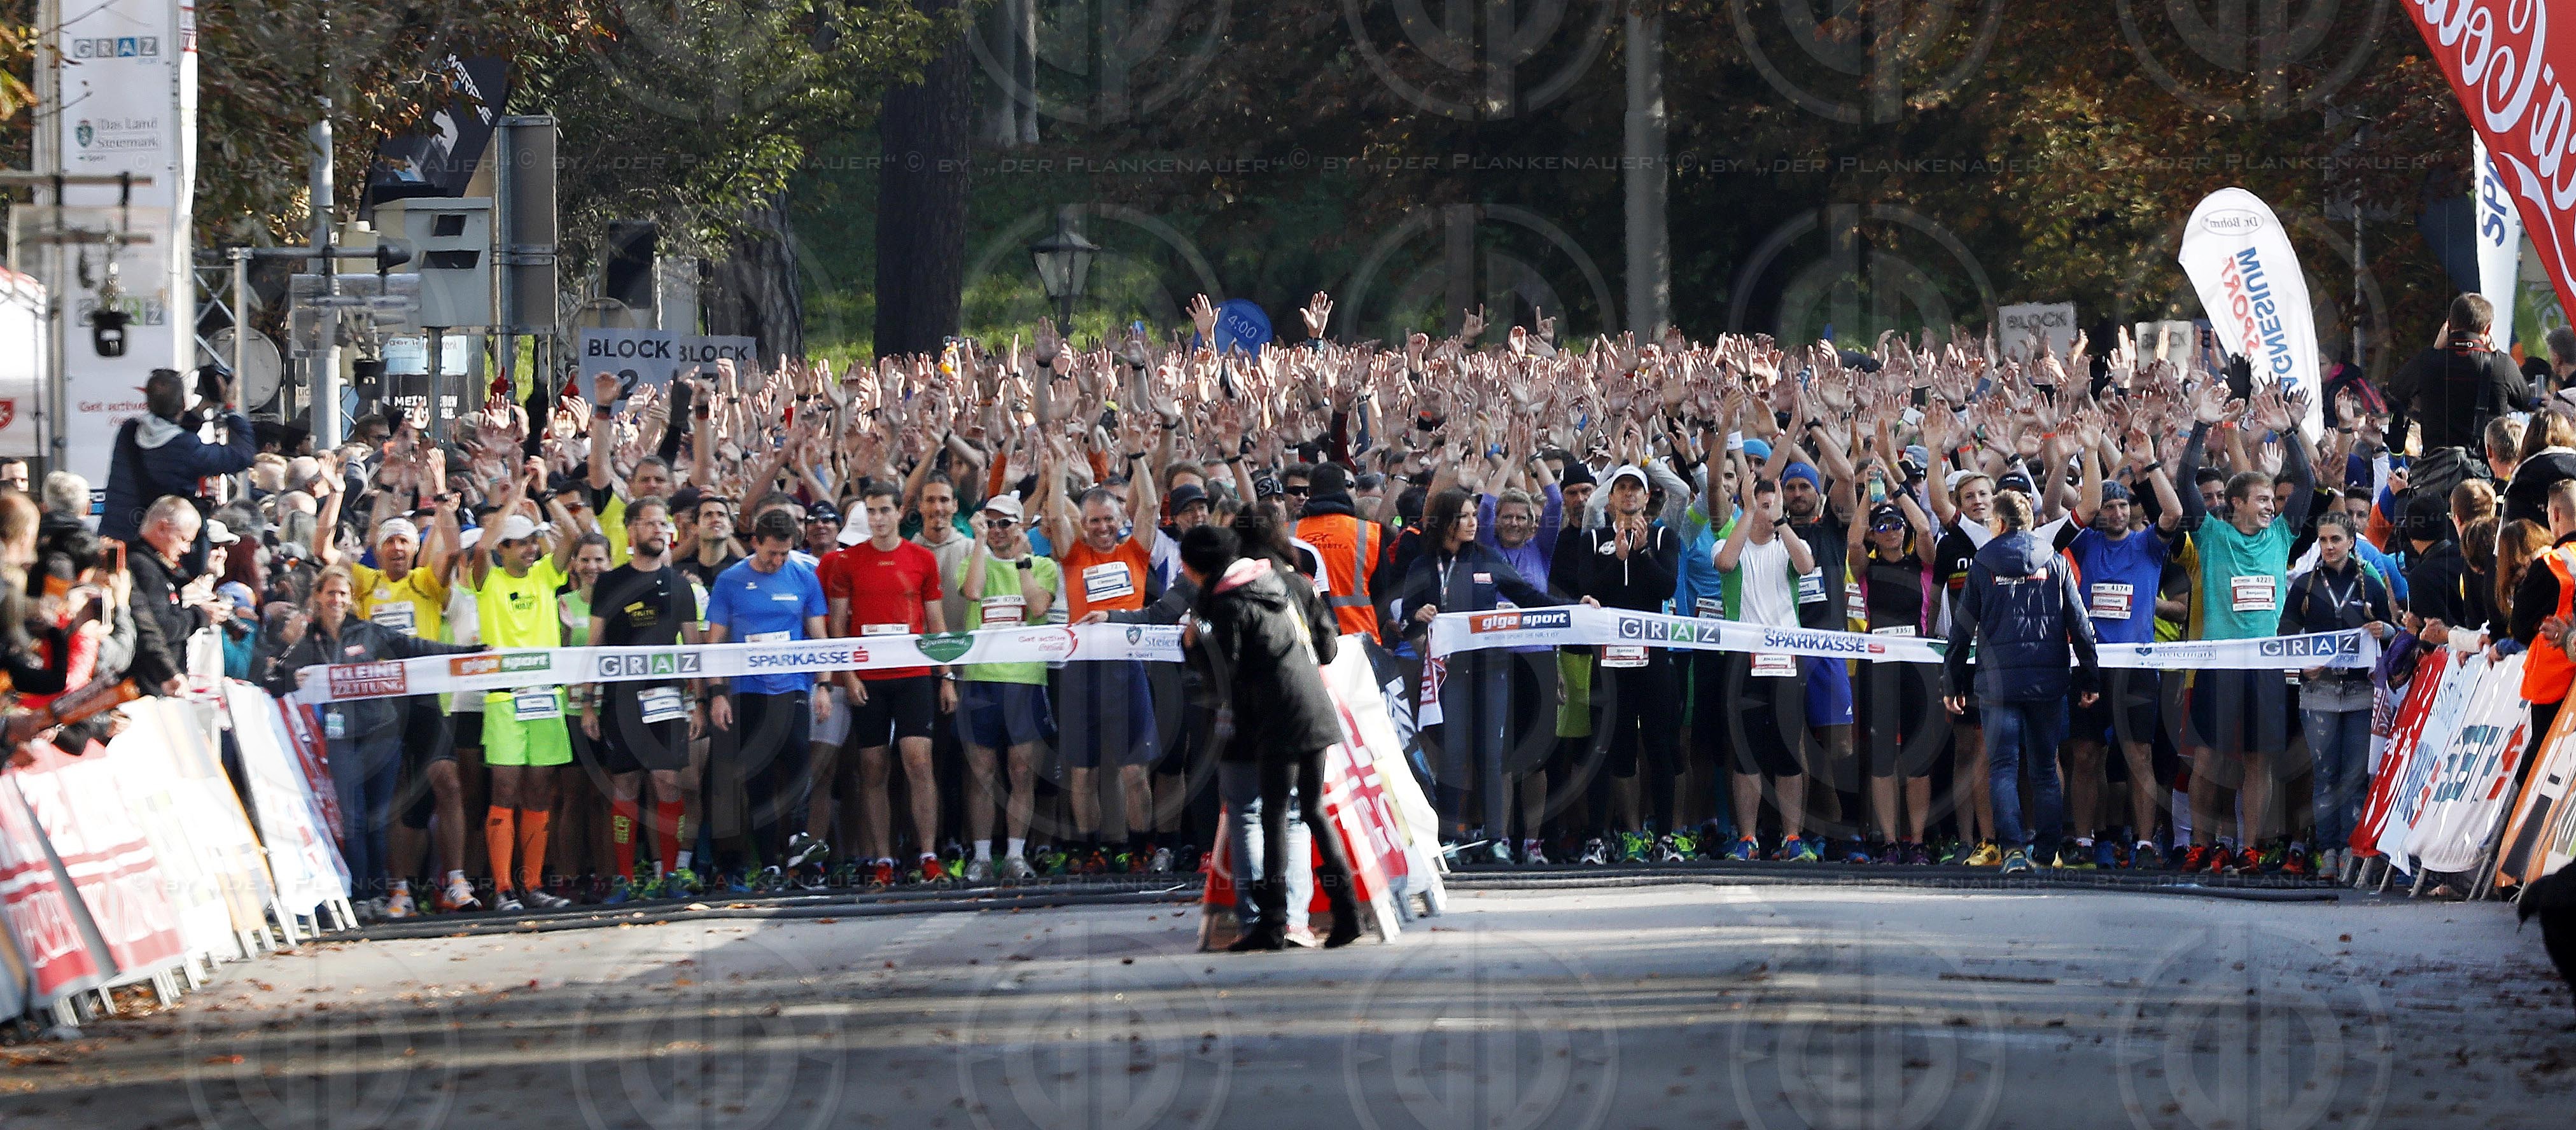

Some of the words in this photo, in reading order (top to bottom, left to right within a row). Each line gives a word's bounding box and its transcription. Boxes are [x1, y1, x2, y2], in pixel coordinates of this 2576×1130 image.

[74, 37, 157, 58] GRAZ
[1228, 316, 1257, 338] 4:00
[588, 338, 671, 358] BLOCK
[617, 368, 639, 401] 2
[1482, 615, 1518, 631] giga
[1522, 613, 1567, 627] sport
[1622, 618, 1717, 642] GRAZ
[1765, 635, 1865, 653] SPARKASSE
[2262, 636, 2355, 657] GRAZ
[599, 653, 698, 676] GRAZ
[748, 651, 849, 667] SPARKASSE
[333, 663, 401, 680] KLEINE
